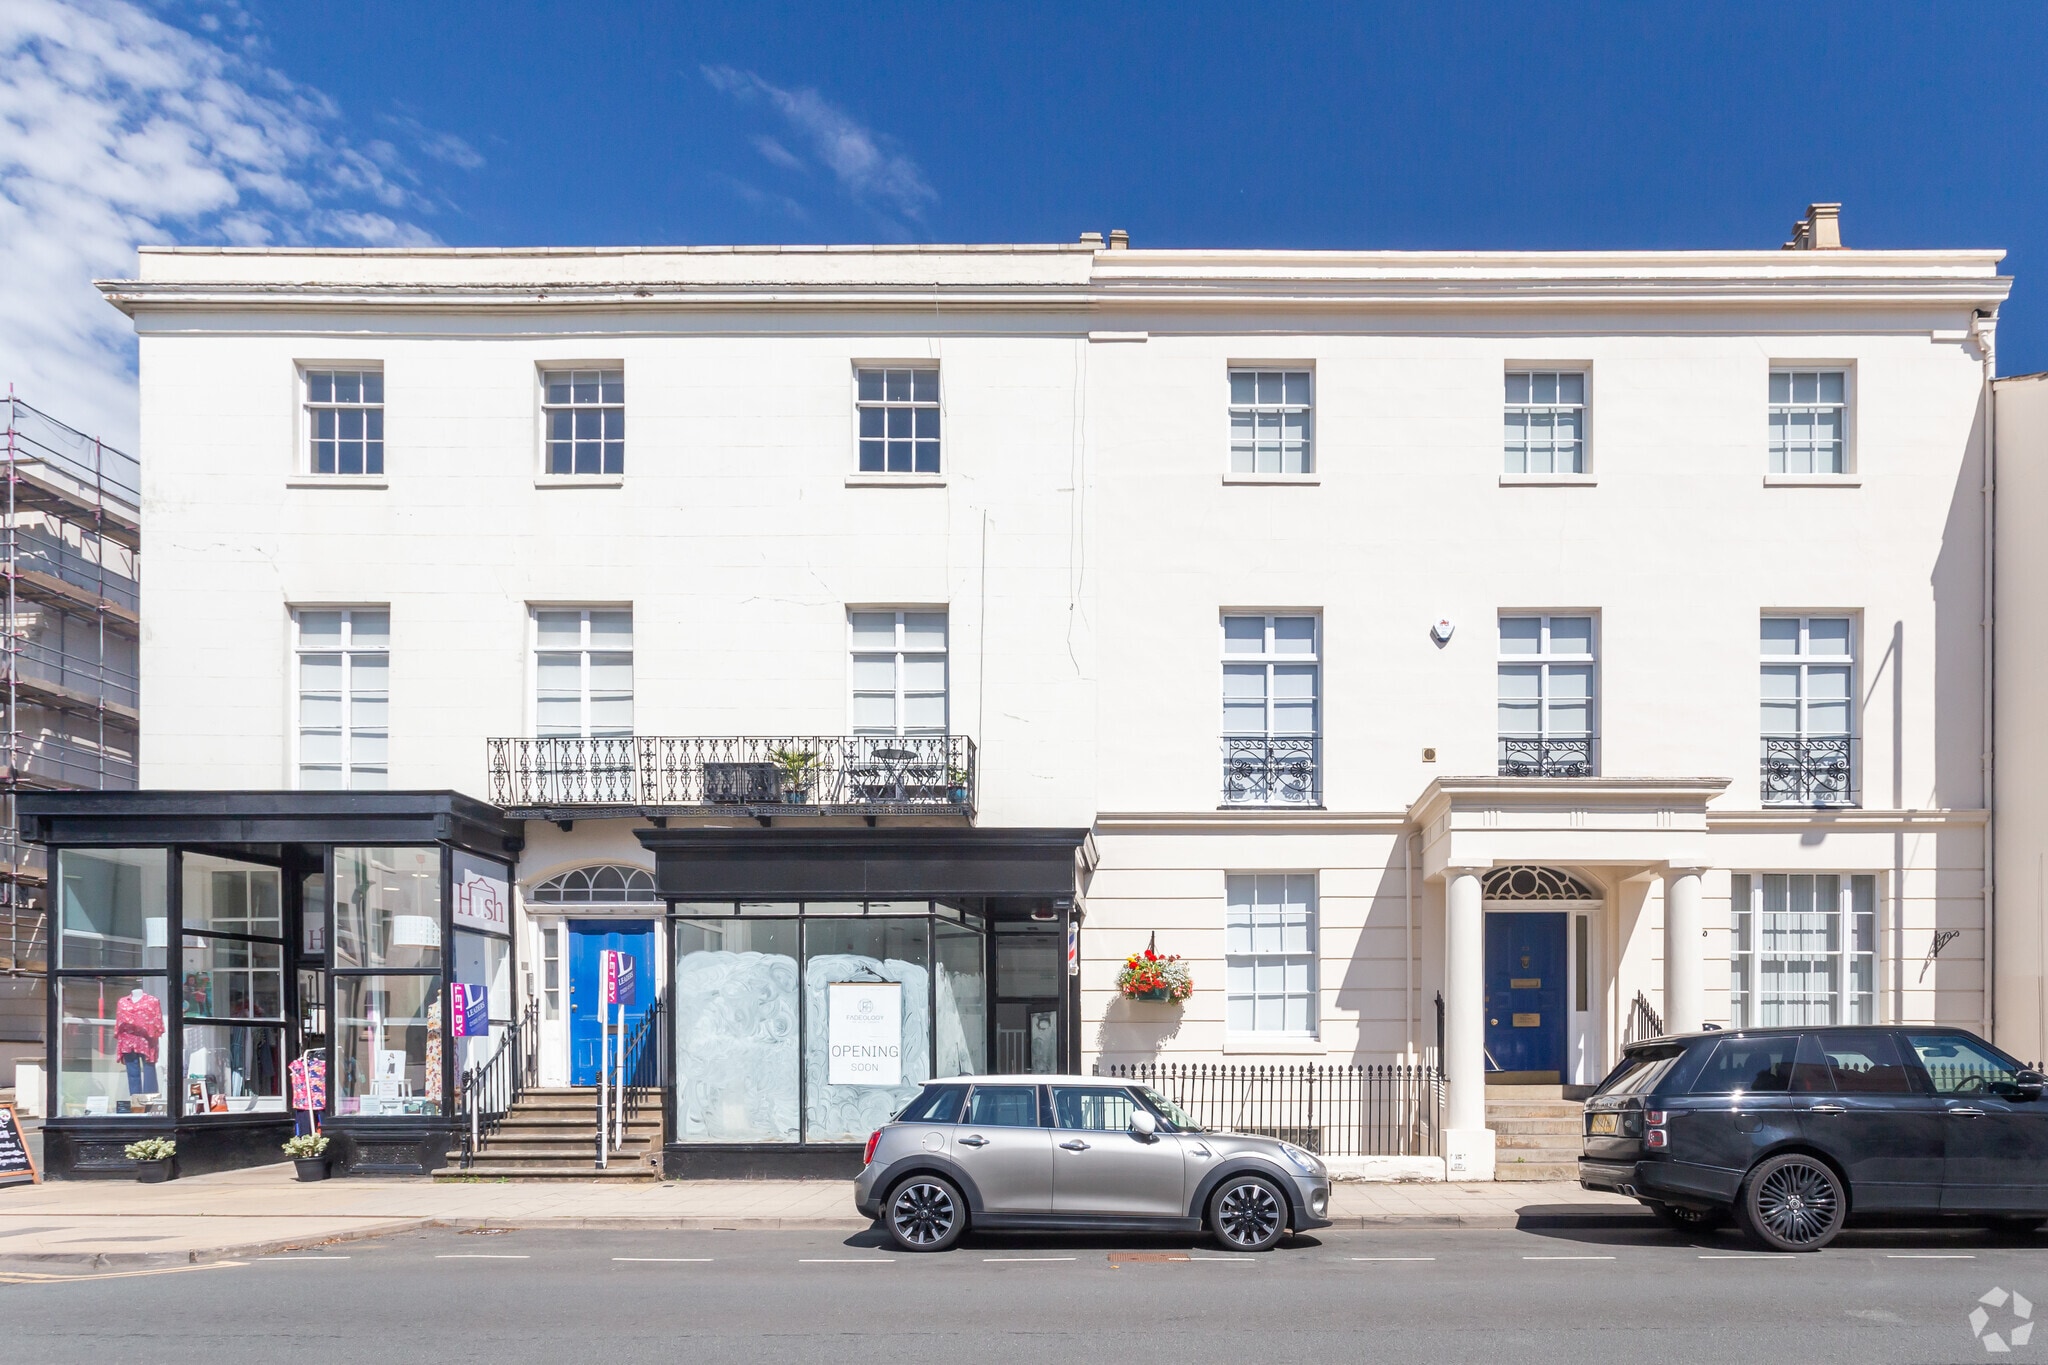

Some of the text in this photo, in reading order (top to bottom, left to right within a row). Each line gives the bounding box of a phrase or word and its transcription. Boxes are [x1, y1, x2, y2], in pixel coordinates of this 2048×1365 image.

[454, 985, 463, 1034] LET BY
[831, 1044, 899, 1058] OPENING
[850, 1062, 879, 1072] SOON
